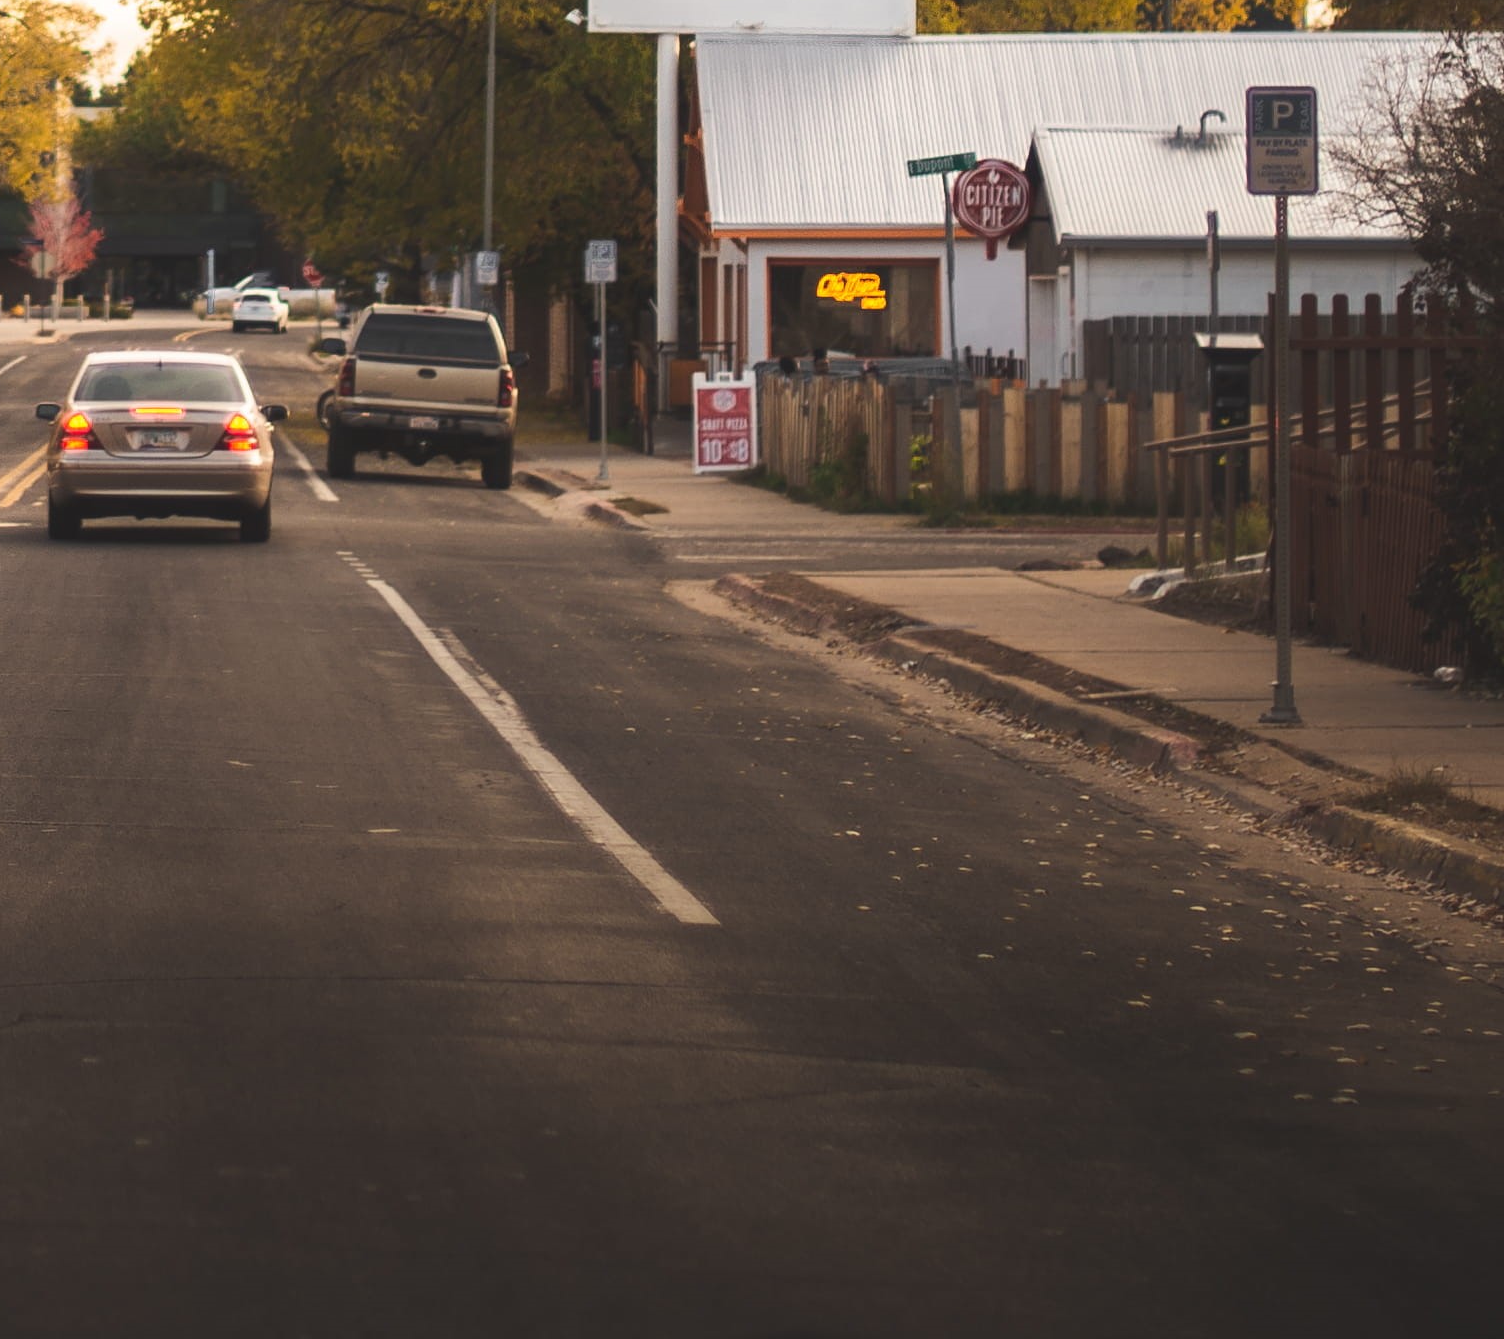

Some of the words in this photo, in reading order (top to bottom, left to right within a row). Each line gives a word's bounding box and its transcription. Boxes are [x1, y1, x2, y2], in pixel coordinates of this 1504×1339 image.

[1272, 100, 1294, 130] P
[966, 185, 1021, 206] CITIZEN
[982, 206, 1003, 227] PIE
